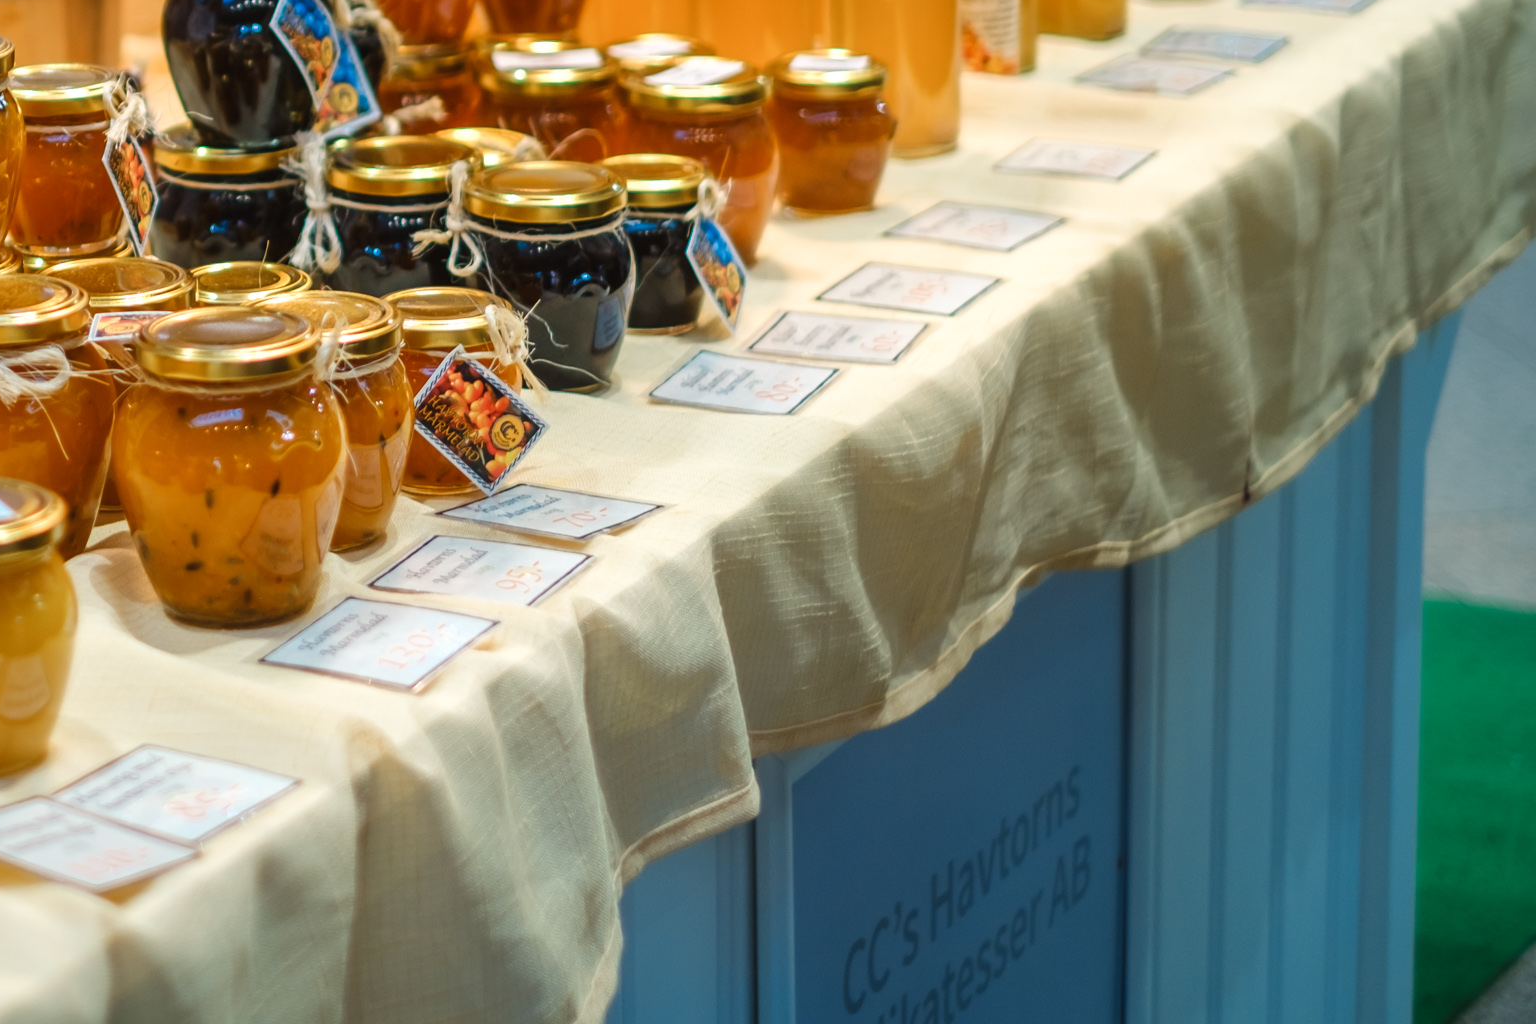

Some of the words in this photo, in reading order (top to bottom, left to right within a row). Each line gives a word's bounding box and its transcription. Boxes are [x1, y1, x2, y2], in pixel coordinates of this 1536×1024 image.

[418, 404, 481, 463] MARMELAD
[428, 394, 485, 450] HAVTORNS
[551, 506, 609, 528] 70:-
[494, 560, 544, 596] 95:-
[319, 609, 389, 658] Marmelad
[376, 622, 448, 672] 130:-
[843, 900, 920, 1016] CC's
[929, 763, 1082, 944] Havtorns
[1048, 833, 1091, 931] AB
